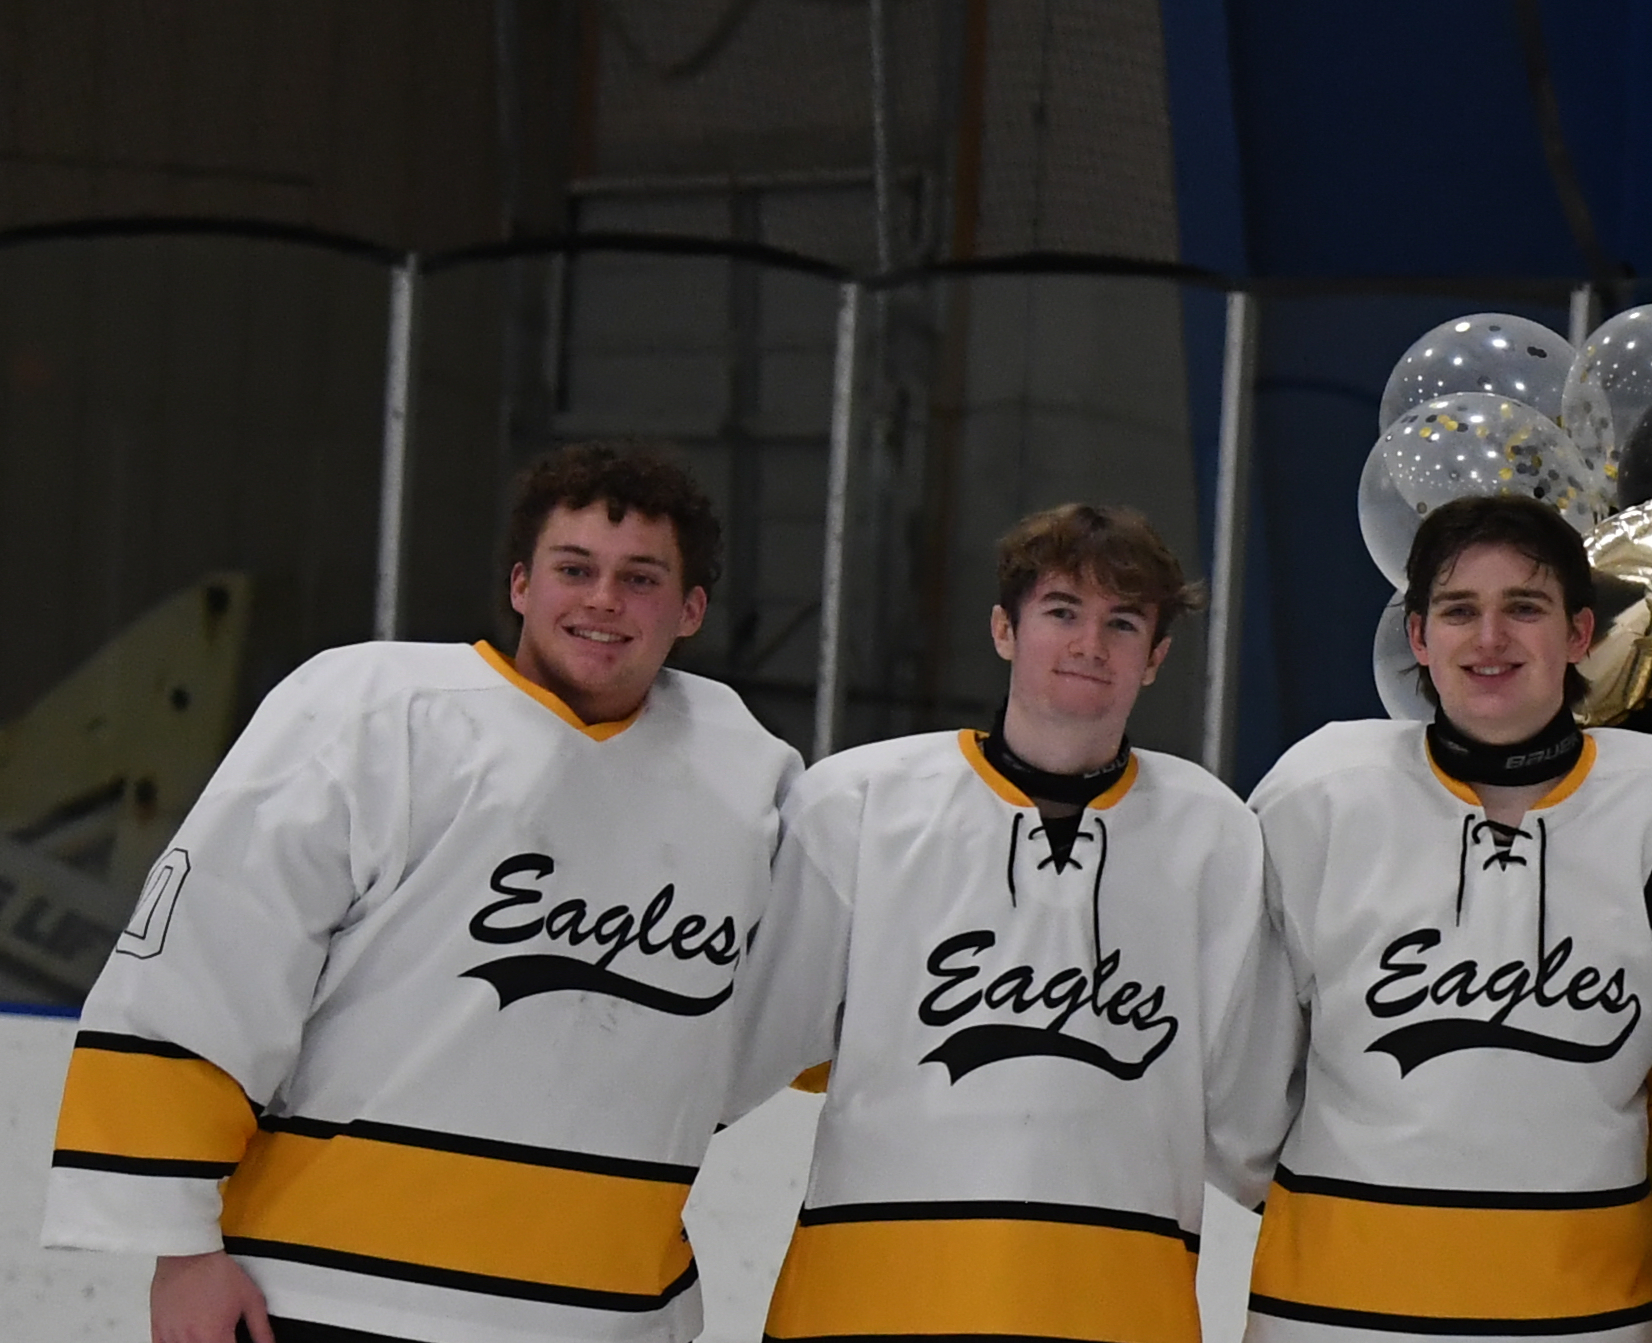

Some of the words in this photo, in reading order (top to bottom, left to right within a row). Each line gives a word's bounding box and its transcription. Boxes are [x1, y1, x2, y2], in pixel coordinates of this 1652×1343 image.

[468, 852, 742, 970] Eagles
[918, 929, 1170, 1034] Eagles
[1366, 927, 1634, 1025] Eagles
